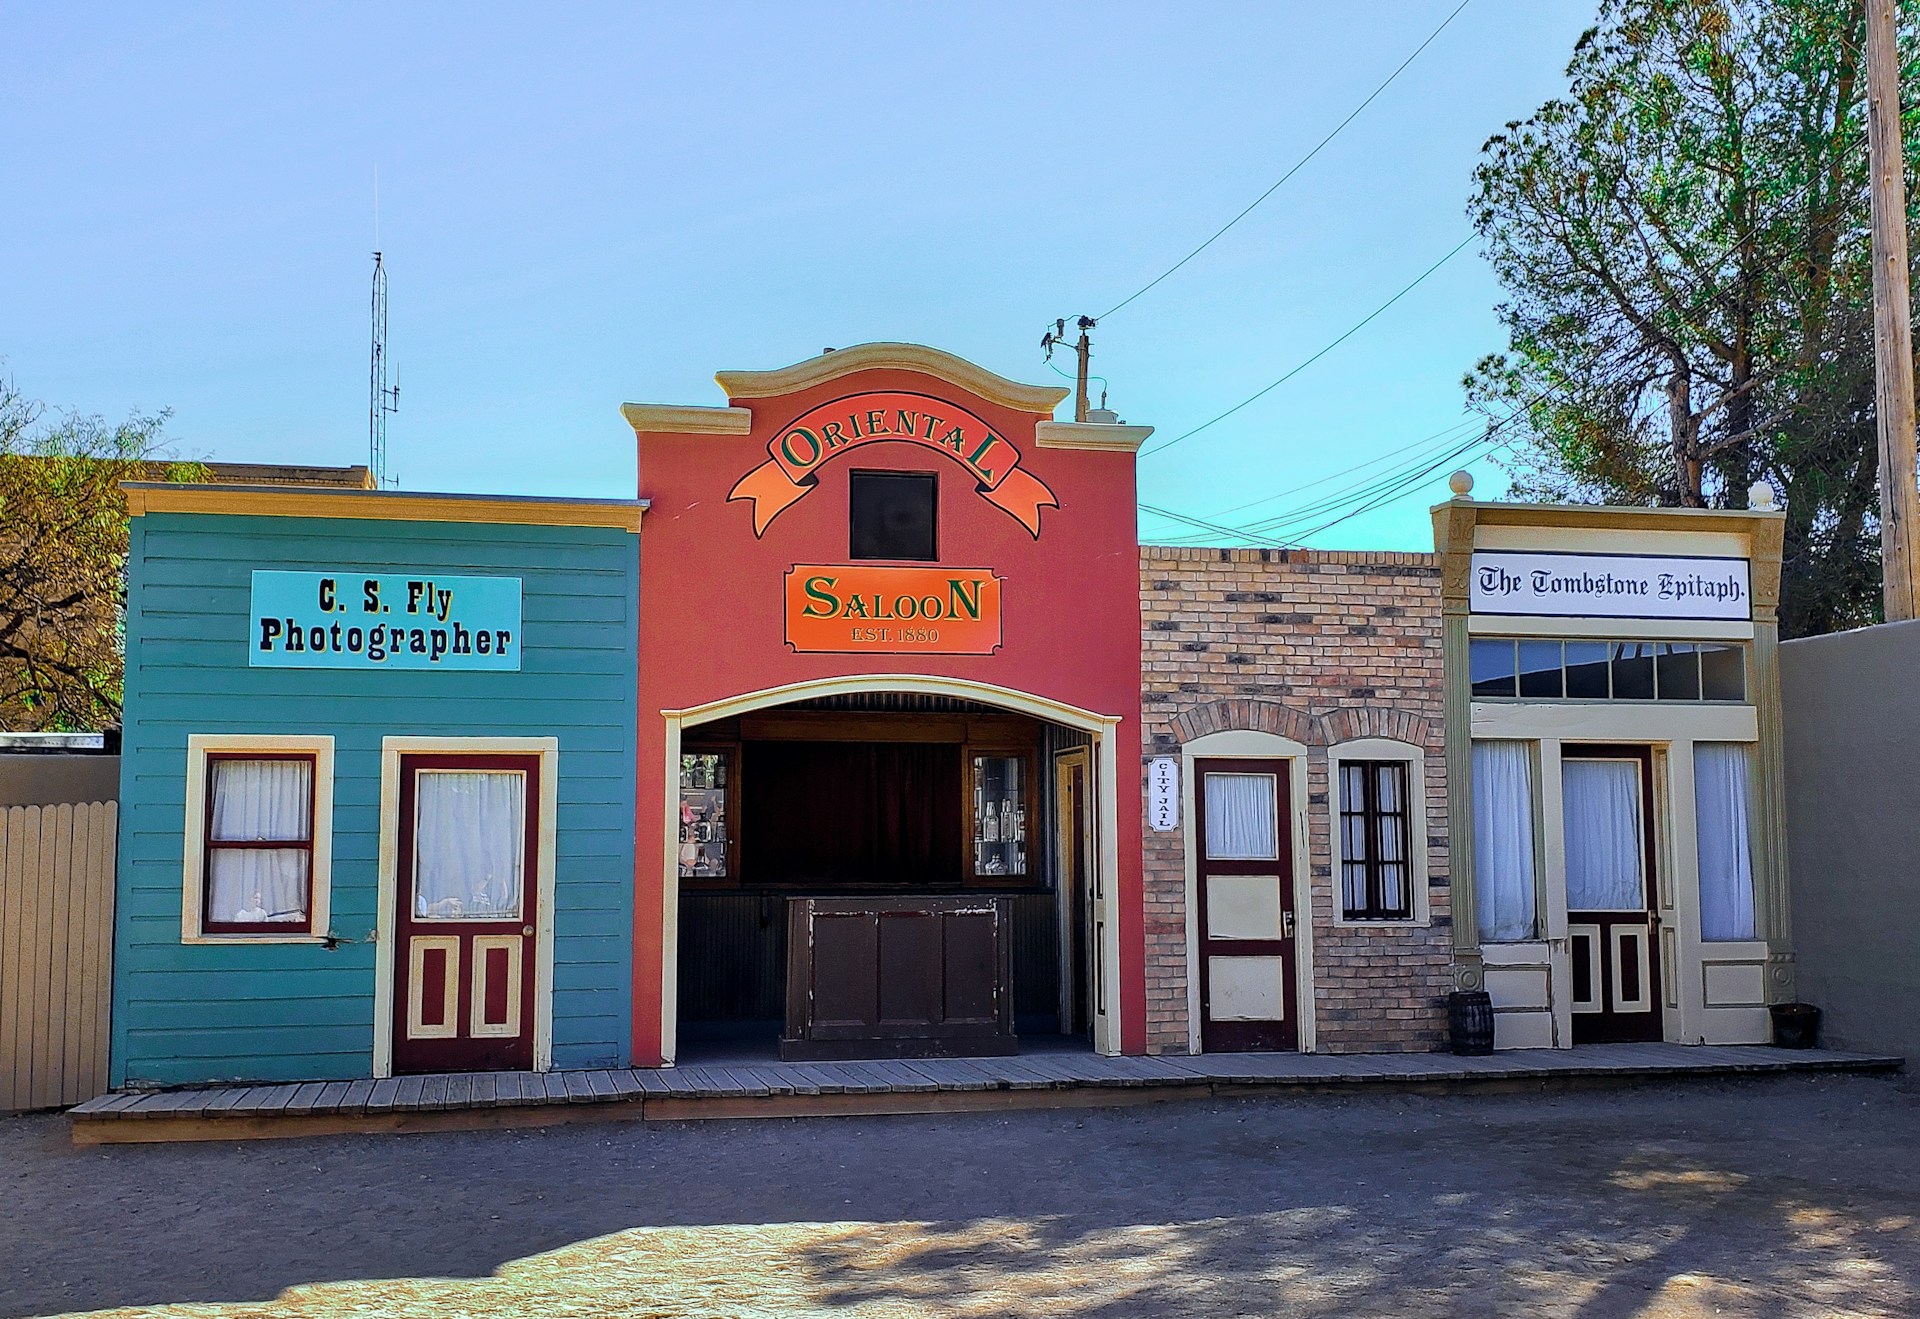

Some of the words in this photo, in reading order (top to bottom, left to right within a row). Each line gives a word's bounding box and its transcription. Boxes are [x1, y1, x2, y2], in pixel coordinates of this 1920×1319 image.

[781, 410, 999, 482] ORIENTAL
[319, 578, 346, 613] C.
[363, 579, 390, 613] S.
[407, 581, 453, 622] Fly
[802, 576, 985, 621] SALOON
[1478, 566, 1523, 596] The
[1530, 569, 1649, 598] Tombstone
[1657, 572, 1745, 602] Epitaph.
[259, 617, 512, 662] Photographer
[851, 627, 893, 642] EST.
[898, 626, 939, 643] 1880
[1157, 763, 1170, 793] CITY
[1158, 797, 1171, 827] JAIL
